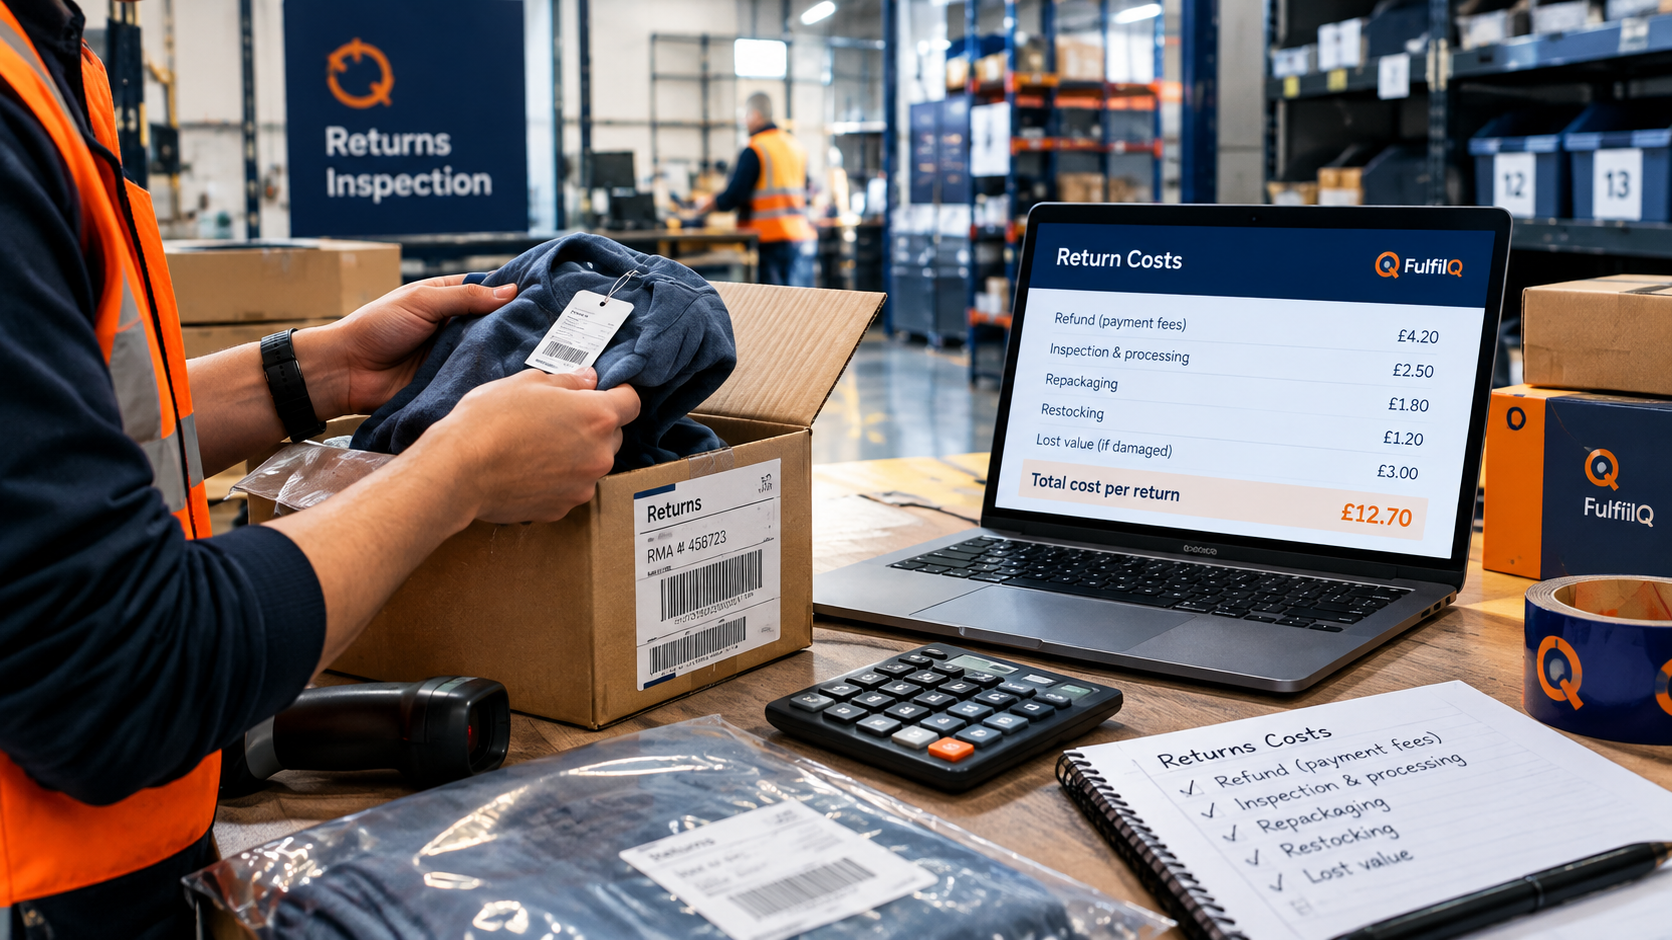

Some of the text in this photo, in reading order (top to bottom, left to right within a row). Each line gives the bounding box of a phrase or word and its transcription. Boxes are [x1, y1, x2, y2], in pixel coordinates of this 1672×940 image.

[325, 126, 452, 157] Returns
[326, 165, 493, 205] Inspection
[1503, 170, 1526, 198] 12
[1605, 170, 1631, 199] 13
[1056, 247, 1183, 270] Return Costs
[1404, 258, 1463, 278] FulfilQ
[1054, 312, 1188, 333] Refund (payment fees)
[1397, 329, 1440, 344] £4.20
[1050, 343, 1190, 366] Inspection & processing
[1045, 373, 1119, 393] Repackaging
[1392, 363, 1434, 378] £2.50
[1041, 403, 1105, 423] Restocking
[1388, 397, 1430, 412] £1.80
[1036, 433, 1173, 459] Lost value (if damaged)
[1383, 430, 1424, 446] £1.20
[1376, 464, 1419, 480] £3.00
[1031, 472, 1181, 502] Total cost per return
[647, 498, 702, 524] Returns
[1341, 502, 1413, 527] £12.70
[647, 544, 674, 564] RMA
[1157, 727, 1333, 769] Returns Costs
[1214, 731, 1442, 789] Refund (payment fees)
[1234, 753, 1468, 811] Inspection & processing
[1256, 798, 1391, 834] Repackaging
[1279, 824, 1400, 858] Restocking
[1302, 849, 1414, 885] Lost value
